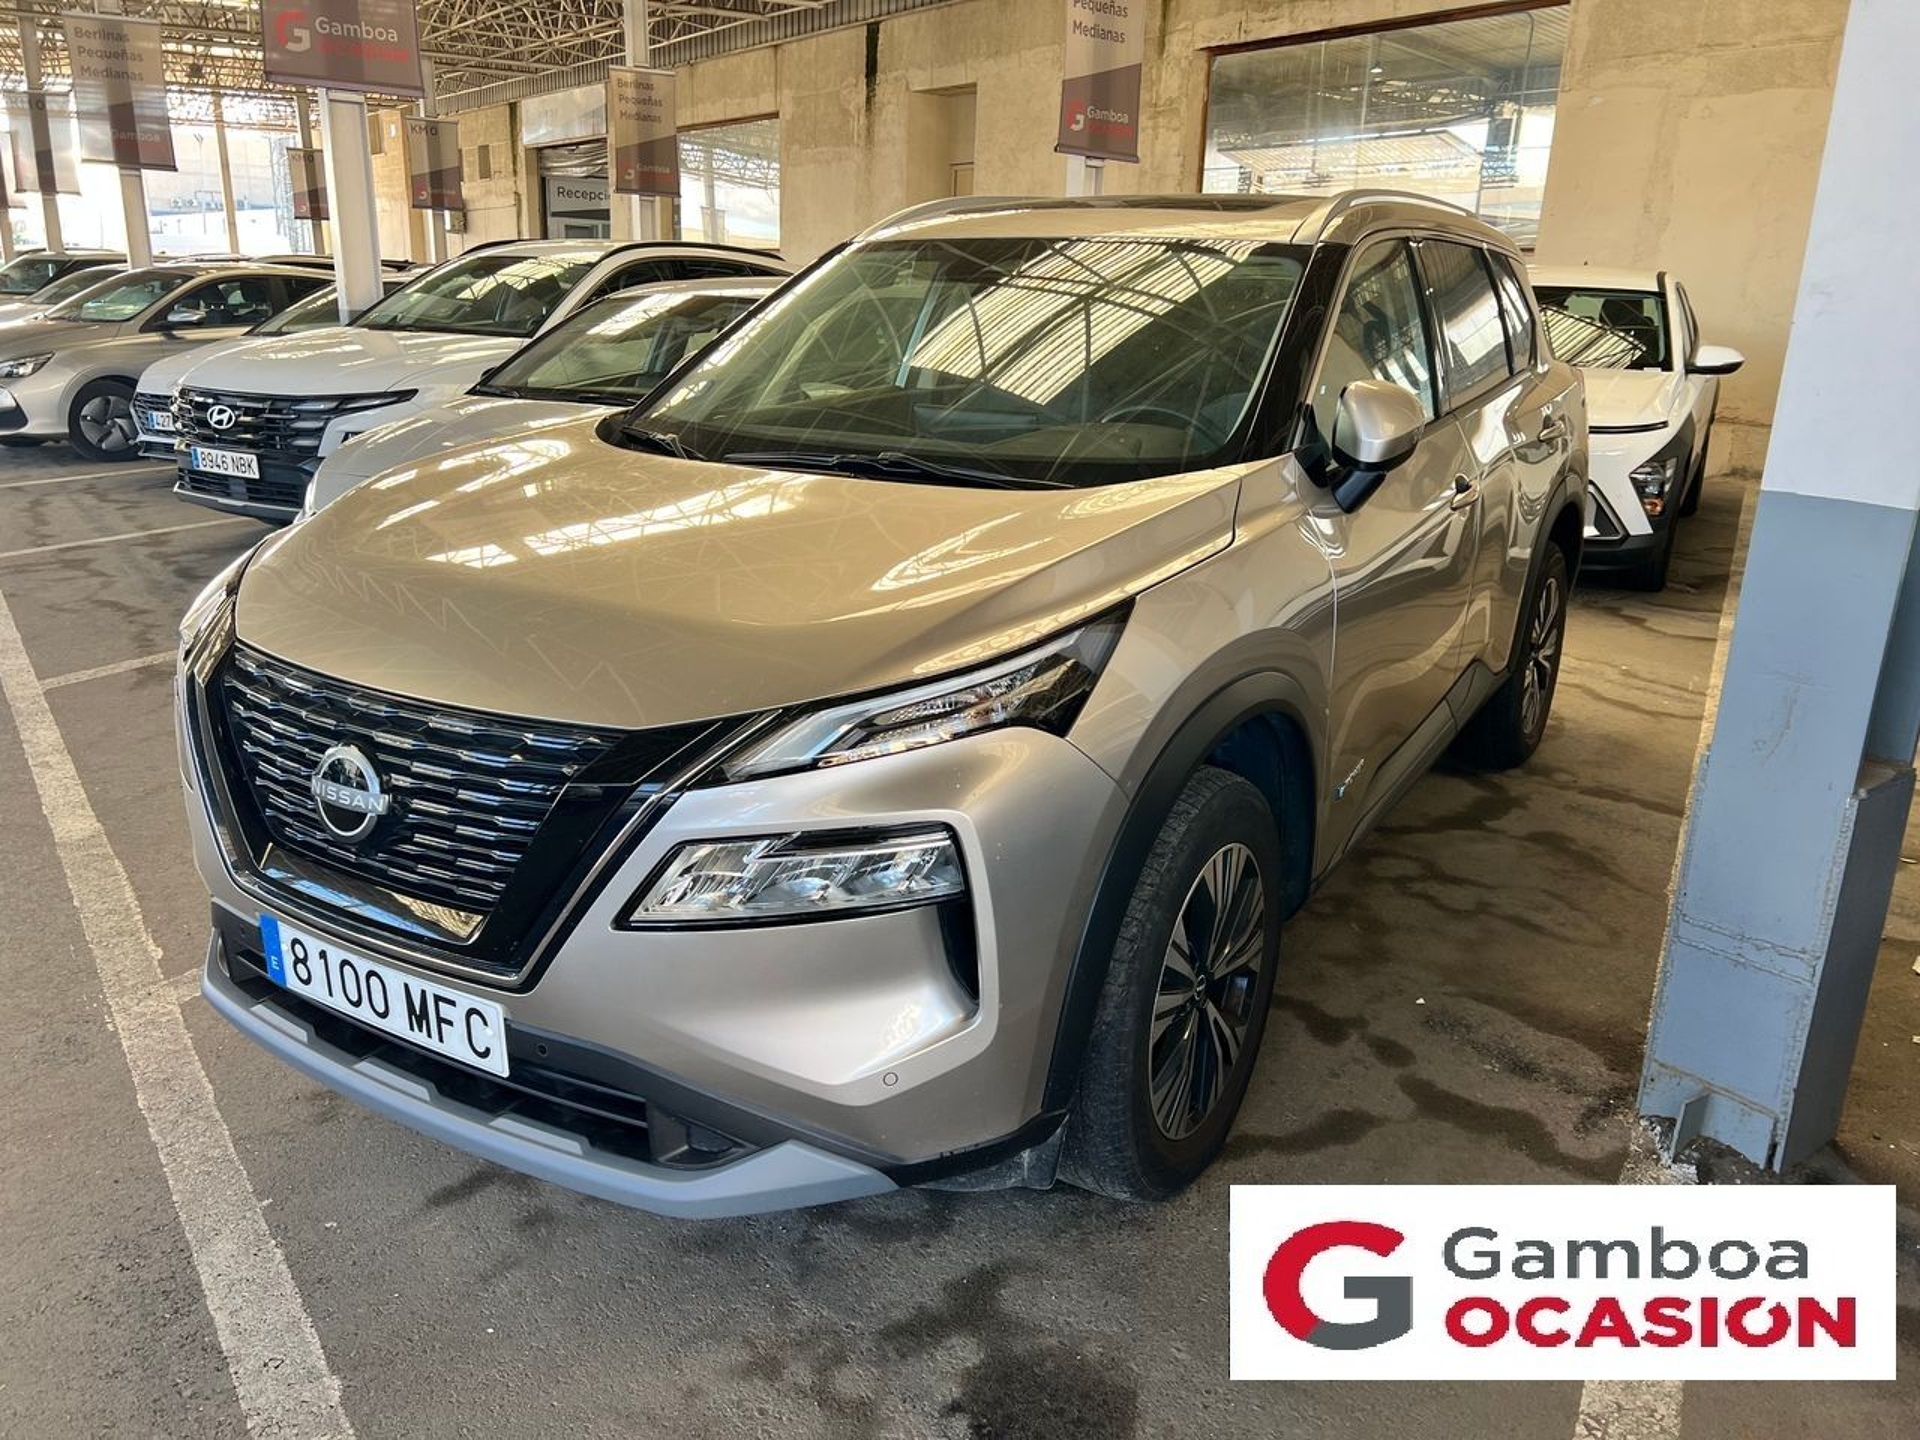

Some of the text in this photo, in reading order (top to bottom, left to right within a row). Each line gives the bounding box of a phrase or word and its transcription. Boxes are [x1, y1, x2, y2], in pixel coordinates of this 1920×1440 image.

[73, 26, 130, 43] Berlinas
[314, 16, 399, 43] Gamboa
[1073, 20, 1126, 43] Medianas
[77, 45, 144, 63] Pequeñas
[80, 65, 144, 82] Medianas
[1087, 105, 1129, 124] Gamboa
[201, 451, 229, 471] 8946
[230, 456, 256, 475] NBK
[312, 779, 384, 812] NISSAN
[291, 937, 491, 1059] 8100 MFC
